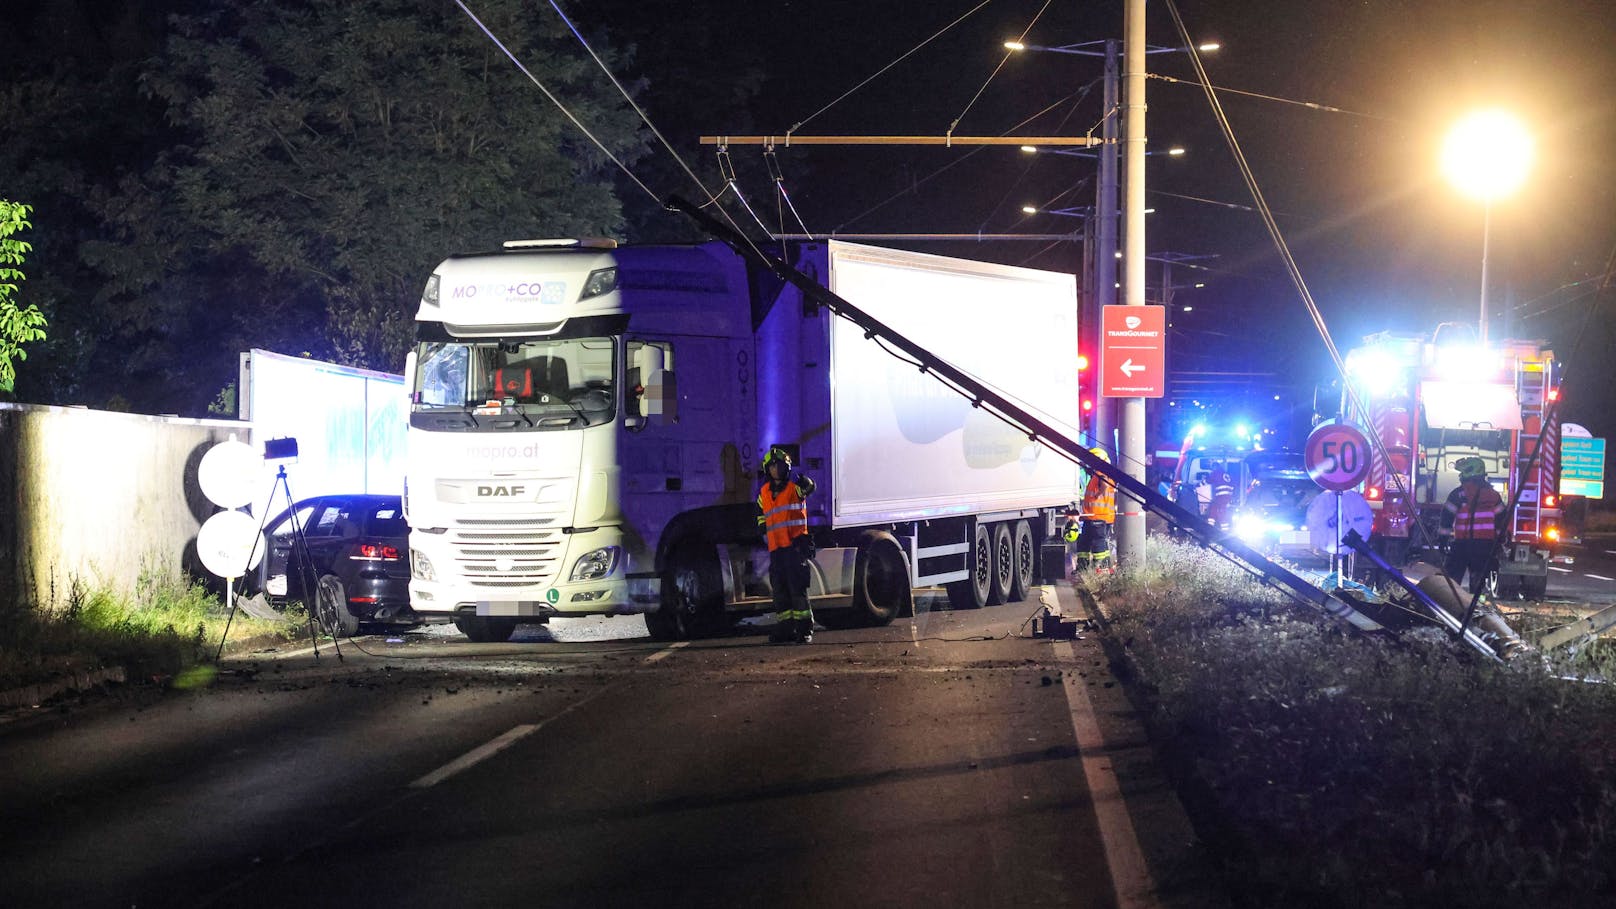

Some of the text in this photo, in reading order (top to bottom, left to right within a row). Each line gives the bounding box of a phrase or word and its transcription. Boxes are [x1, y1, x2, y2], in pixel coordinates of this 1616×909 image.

[466, 442, 539, 461] mopro.at
[1323, 442, 1357, 474] 50
[477, 485, 525, 497] DAF
[550, 591, 557, 602] L
